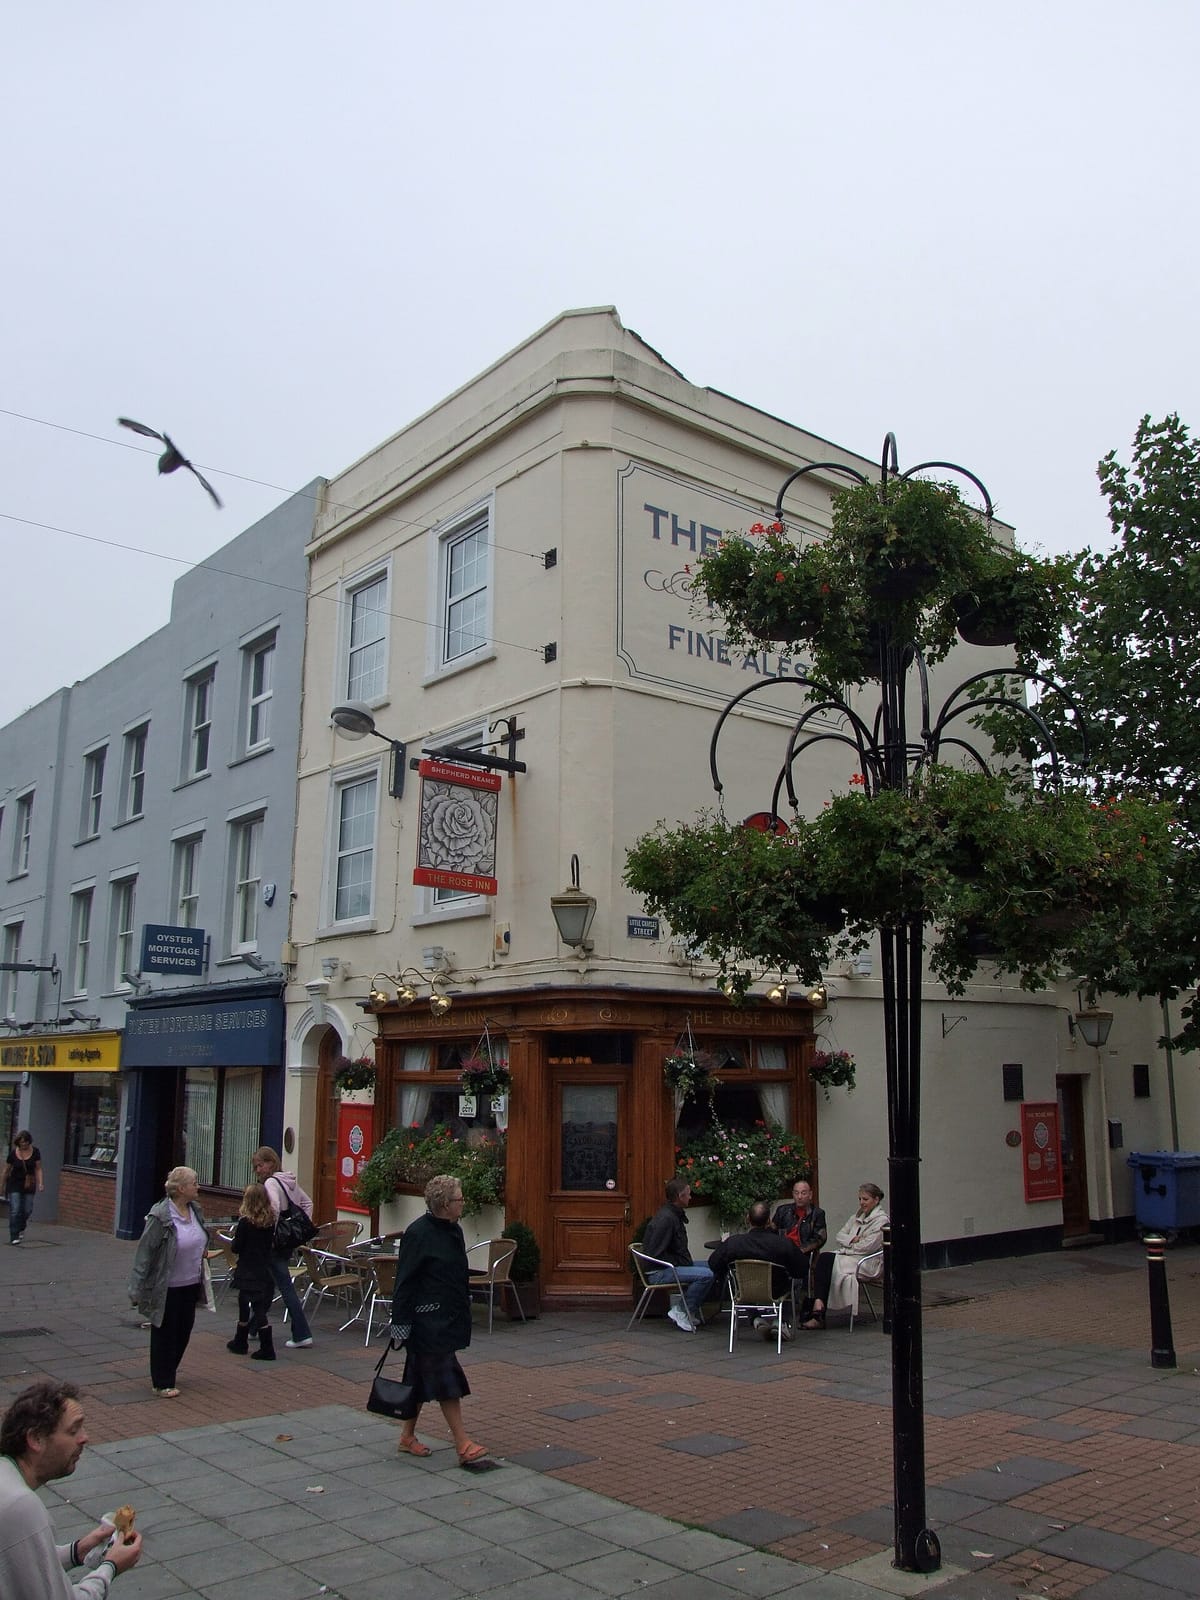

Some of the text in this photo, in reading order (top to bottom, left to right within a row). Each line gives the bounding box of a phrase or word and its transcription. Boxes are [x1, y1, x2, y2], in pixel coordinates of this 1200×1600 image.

[644, 503, 722, 559] THE
[668, 624, 732, 666] FINE
[431, 766, 495, 785] SHEPHERD NEAME
[428, 873, 491, 891] THE ROSE INN
[156, 934, 193, 944] OYSTER
[148, 944, 200, 956] MORTGAGE
[151, 955, 197, 967] SERVICES
[127, 1009, 268, 1035] OYSTER MORTGAGE SERVICES
[427, 1012, 458, 1027] ROSE
[463, 1009, 487, 1024] INN
[722, 1009, 761, 1026] ROSE
[769, 1012, 794, 1026] INN
